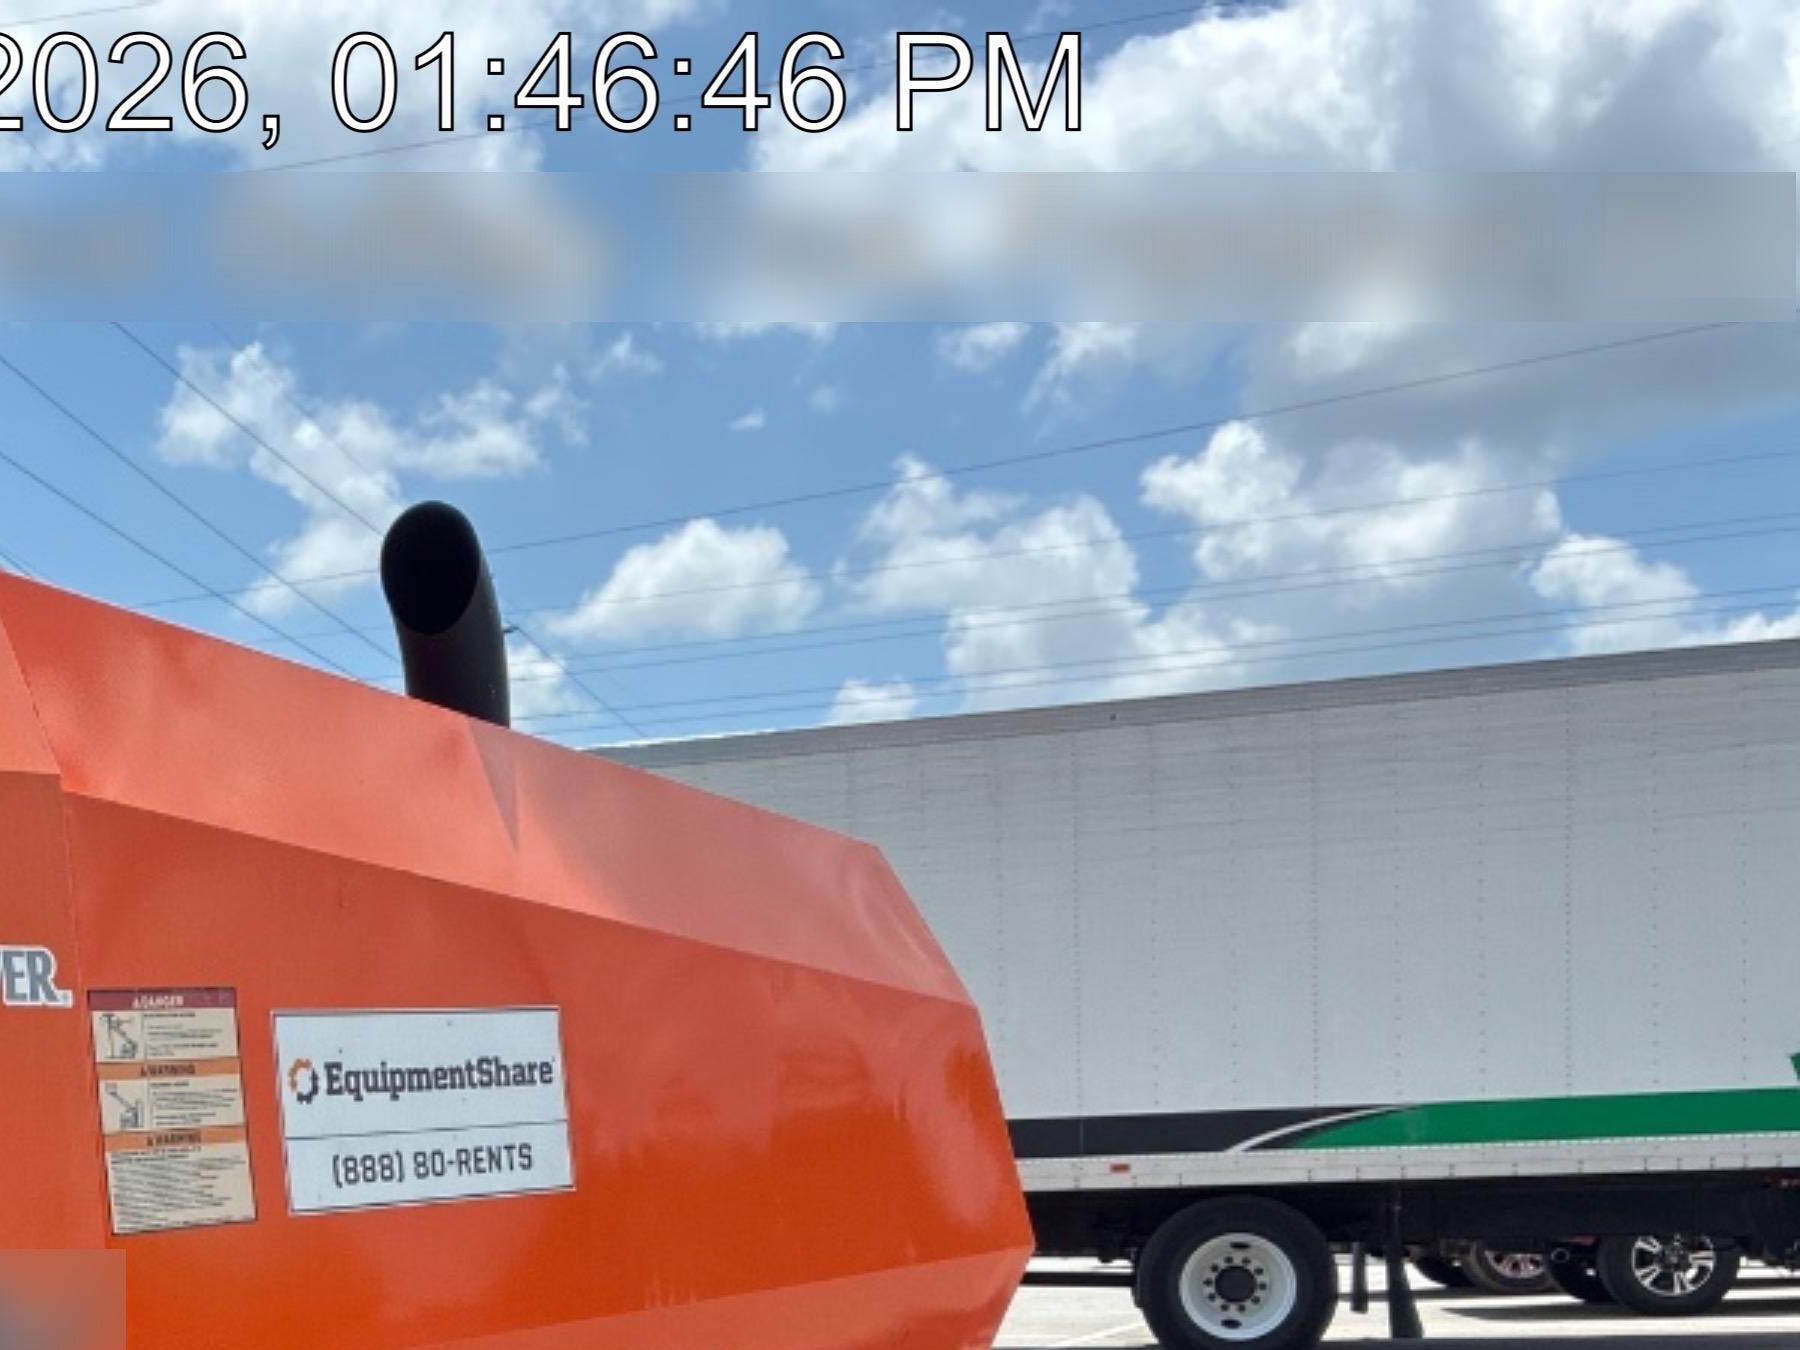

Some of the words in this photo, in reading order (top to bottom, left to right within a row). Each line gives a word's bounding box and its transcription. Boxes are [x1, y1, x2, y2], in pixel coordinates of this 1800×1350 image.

[324, 1056, 553, 1102] EquipmentShare
[332, 1151, 404, 1187] (888)
[413, 1143, 533, 1179] 80-RENTS
